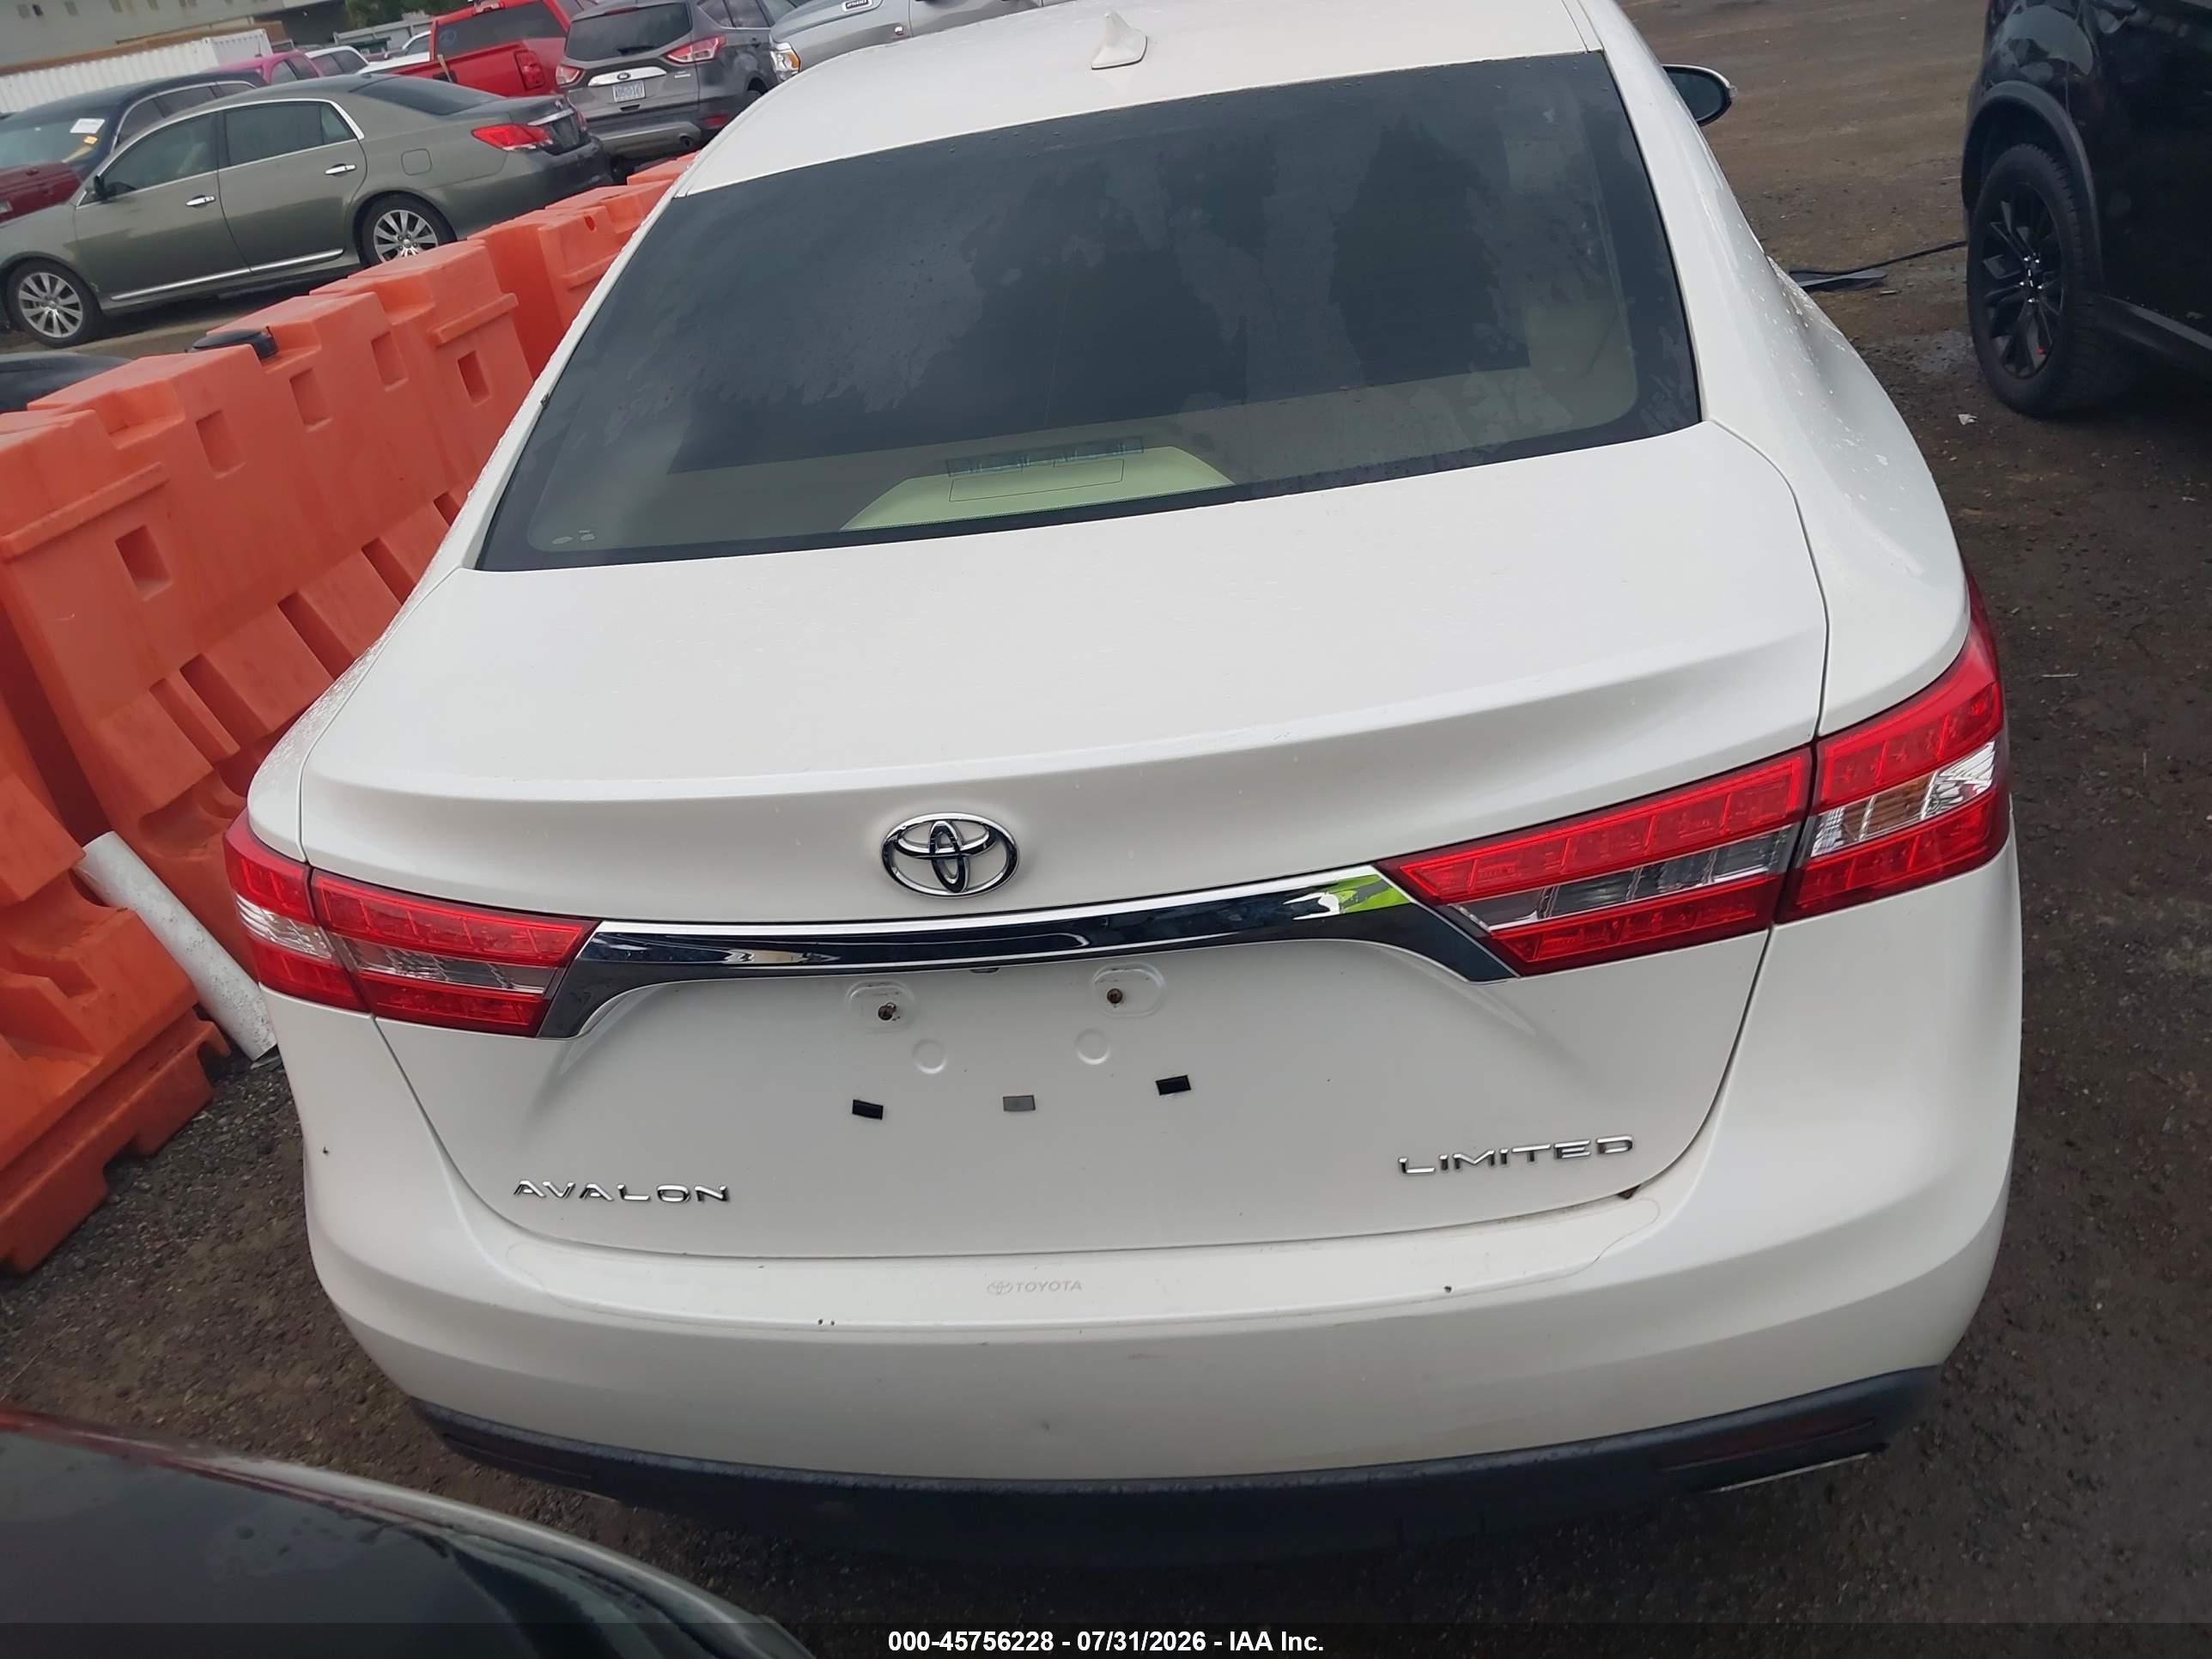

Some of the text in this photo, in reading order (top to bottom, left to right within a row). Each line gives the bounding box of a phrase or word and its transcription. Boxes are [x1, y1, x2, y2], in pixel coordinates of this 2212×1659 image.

[1397, 1134, 1634, 1175] LIMITED
[514, 1179, 730, 1203] AVALON
[1015, 1279, 1083, 1292] TOYOTA
